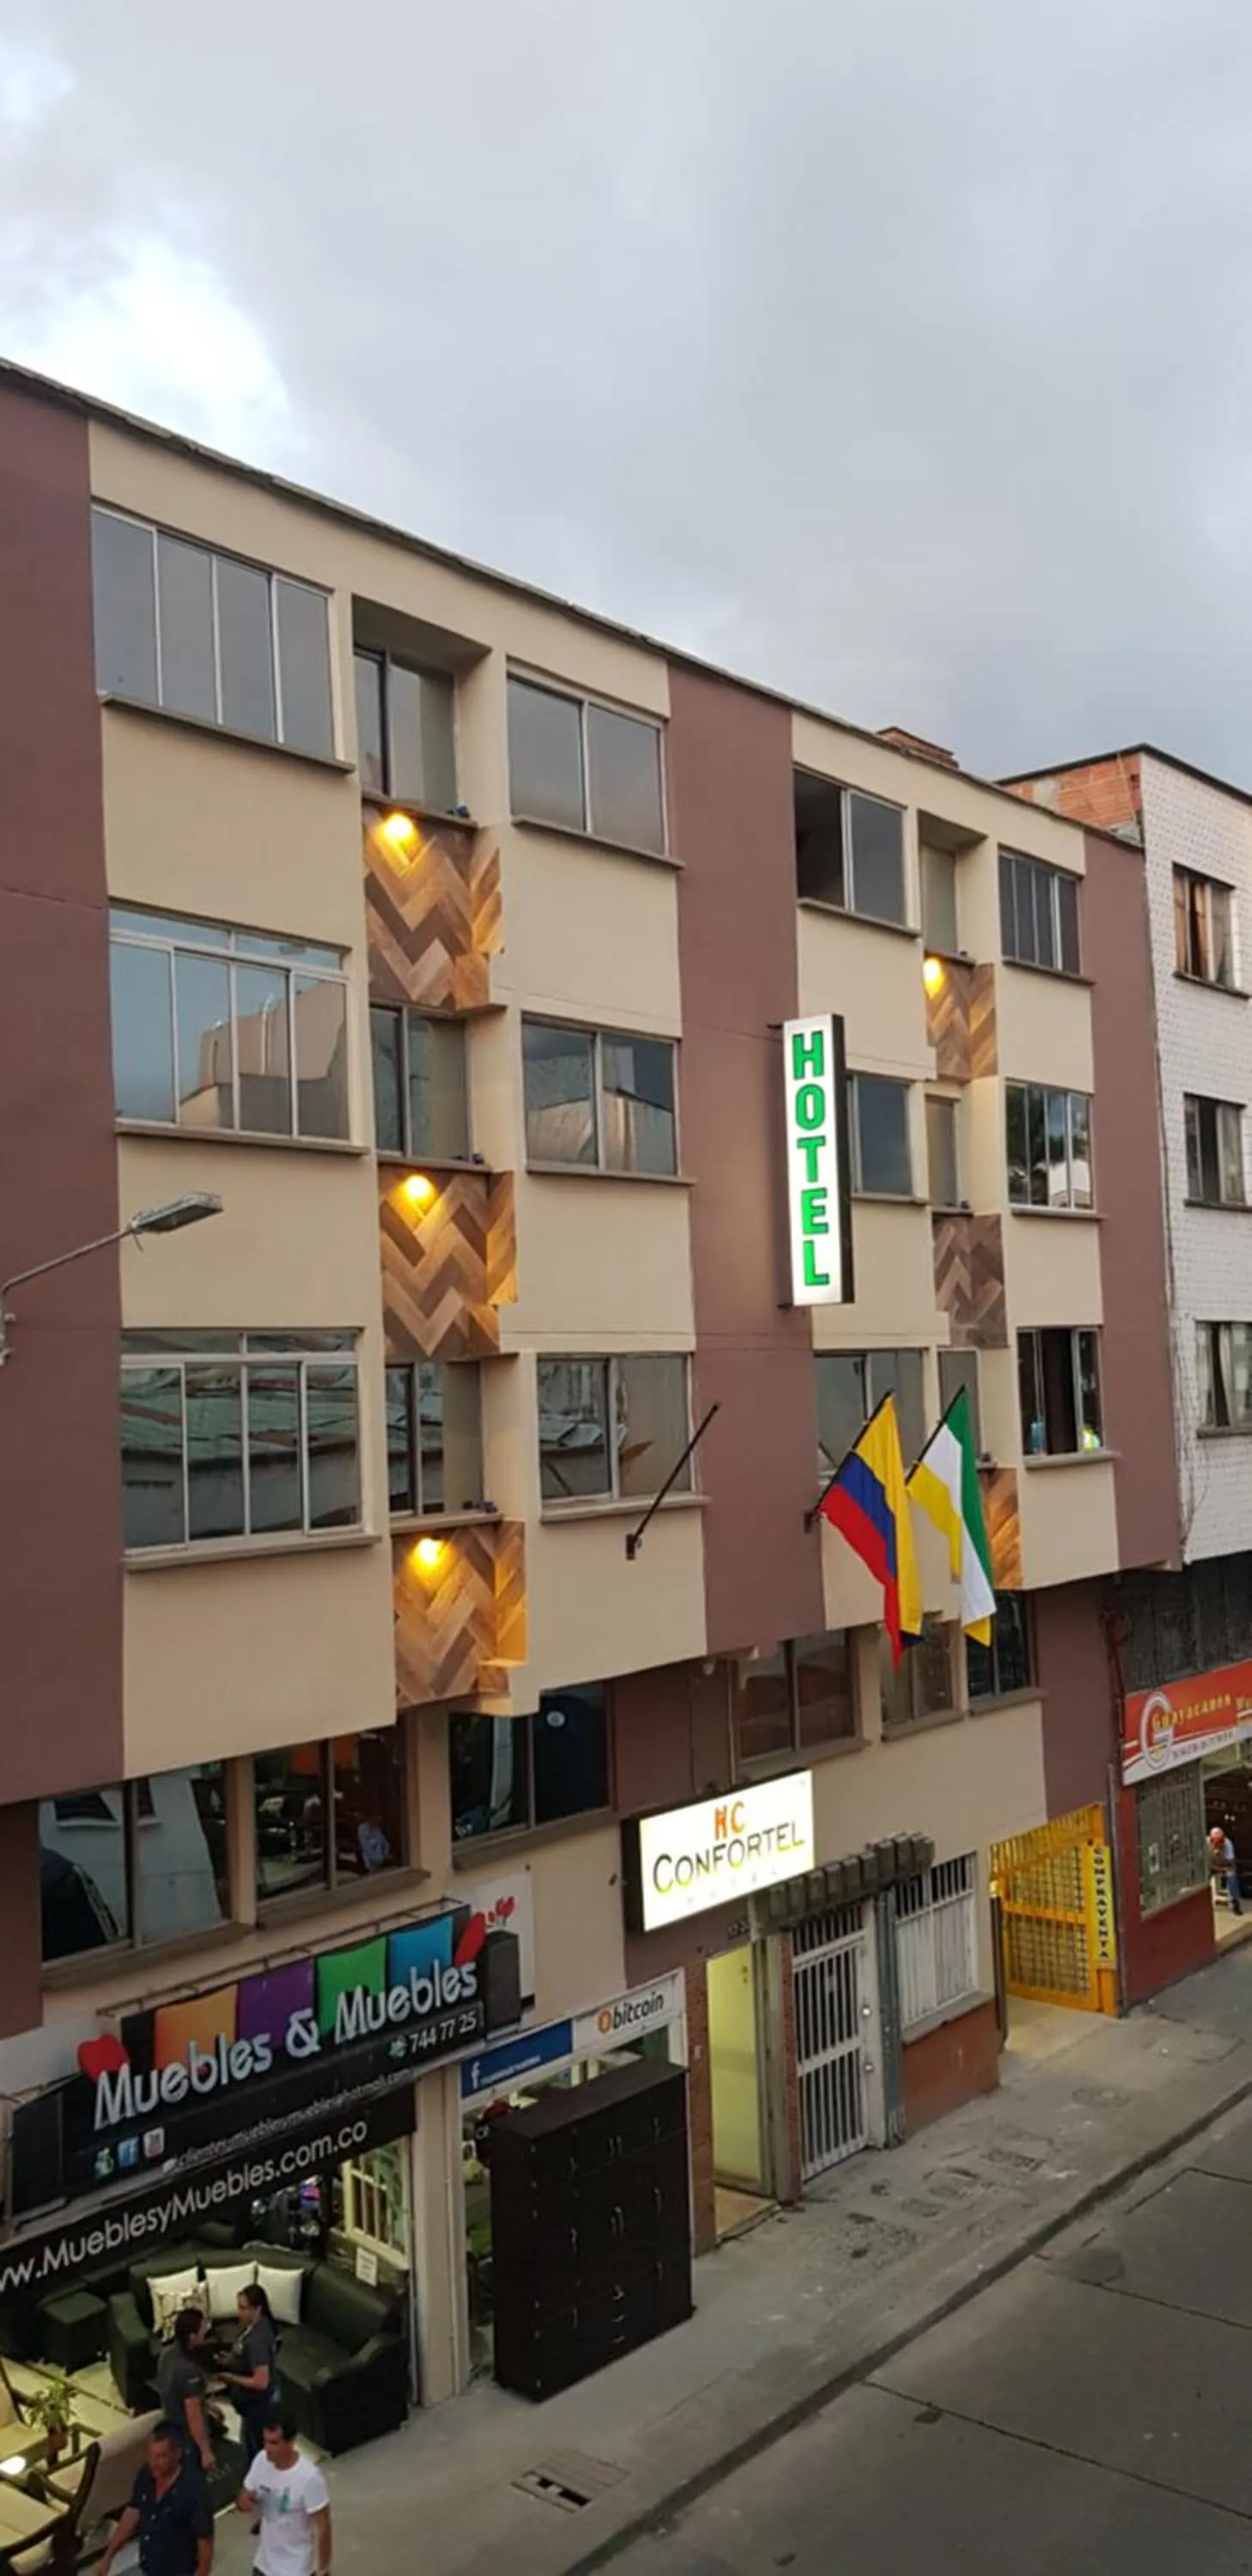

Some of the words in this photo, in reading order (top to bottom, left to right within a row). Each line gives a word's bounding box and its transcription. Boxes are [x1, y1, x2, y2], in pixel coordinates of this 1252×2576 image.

[792, 1030, 830, 1286] HOTEL
[714, 1800, 745, 1841] HC
[1093, 1847, 1109, 1959] COMPRAVENTA
[94, 2032, 273, 2131] Muebles
[285, 2006, 321, 2058] &
[334, 1959, 478, 2045] Muebles
[410, 2028, 437, 2054] 744
[439, 2019, 455, 2041] 77
[459, 2011, 477, 2034] 25
[613, 1990, 665, 2029] bitcoin
